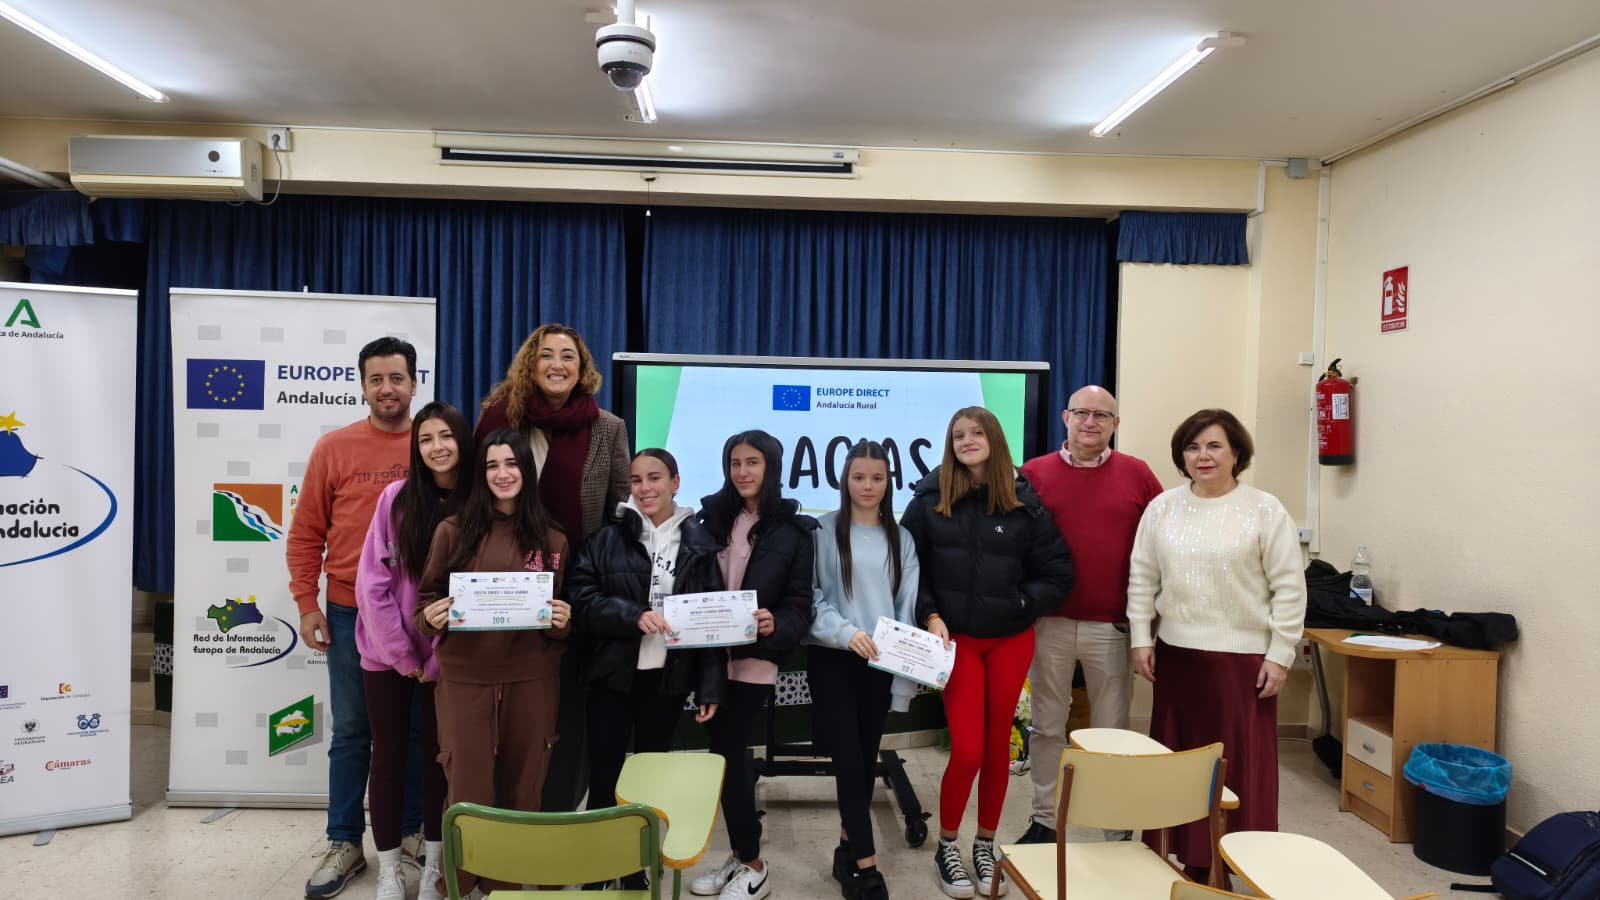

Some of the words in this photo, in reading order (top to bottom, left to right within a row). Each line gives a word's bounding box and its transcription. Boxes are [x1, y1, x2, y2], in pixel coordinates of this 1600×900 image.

[277, 365, 355, 381] EUROPE
[816, 387, 853, 397] EUROPE
[856, 388, 890, 398] DIRECT
[276, 391, 357, 406] Andalucía
[856, 401, 877, 410] Rural
[0, 498, 60, 515] ación
[193, 634, 211, 643] Red
[212, 634, 224, 643] de
[226, 634, 276, 643] Información
[193, 646, 224, 656] Europa
[225, 646, 237, 654] de
[239, 646, 281, 655] Andalucía
